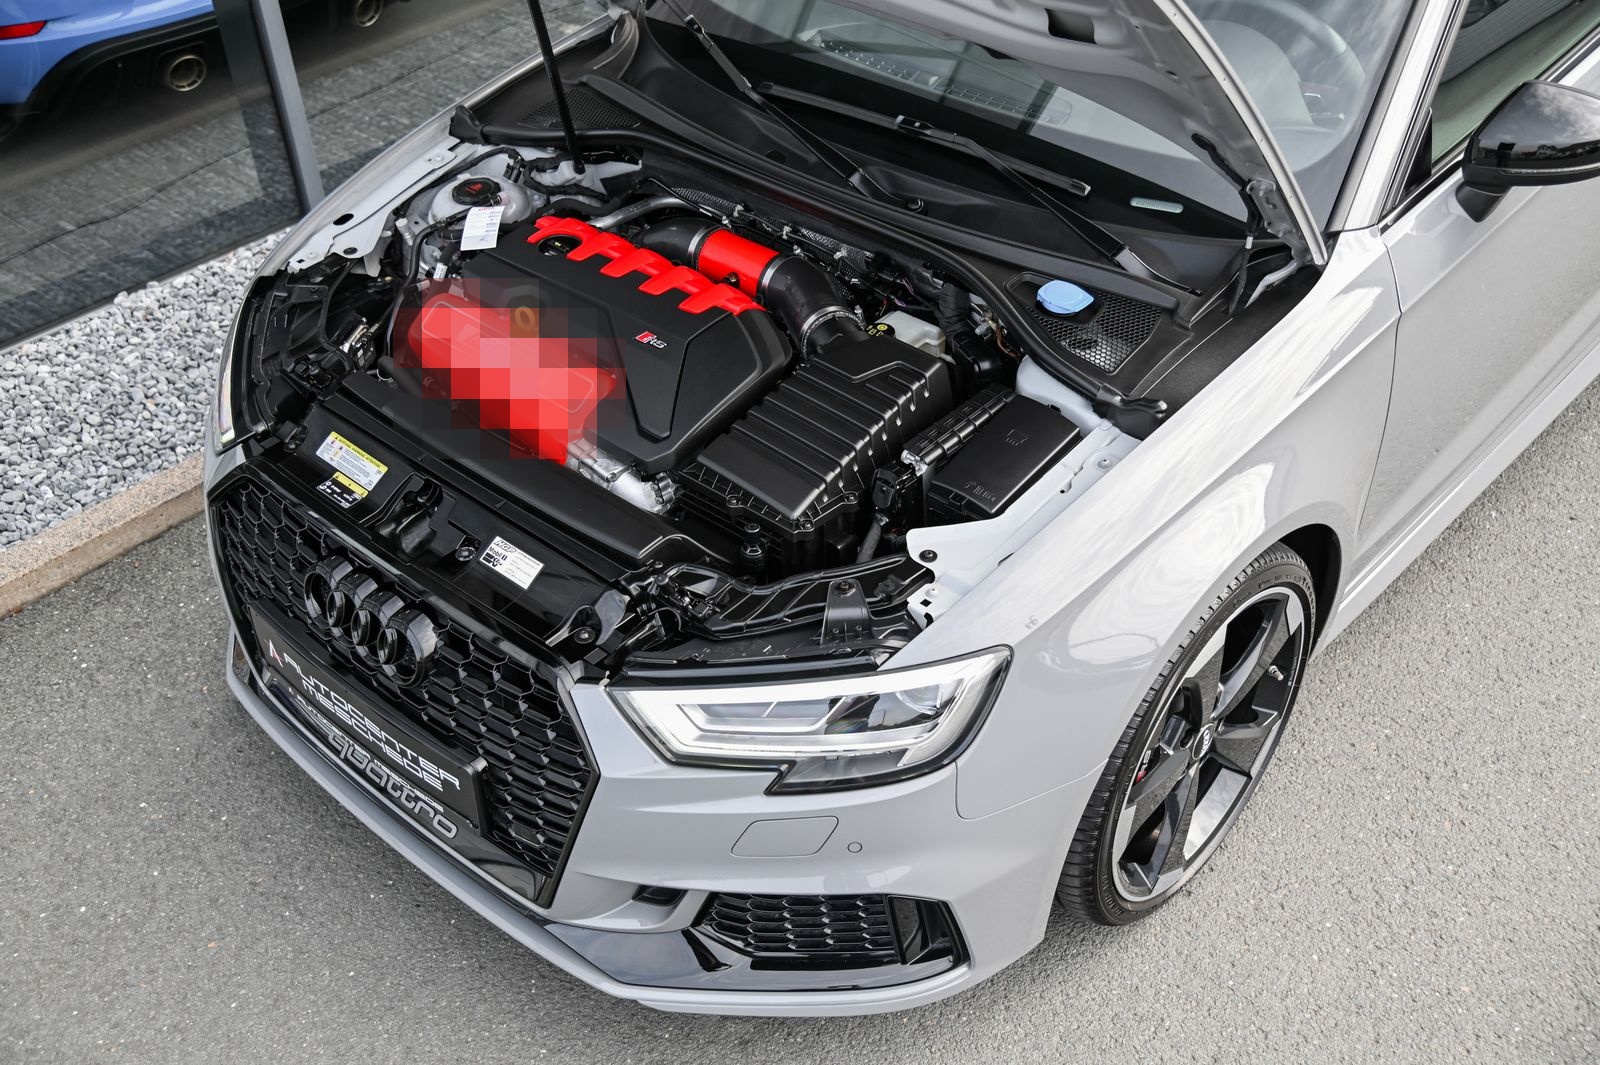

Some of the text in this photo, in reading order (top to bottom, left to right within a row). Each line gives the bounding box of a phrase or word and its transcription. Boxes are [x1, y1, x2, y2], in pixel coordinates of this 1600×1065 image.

[283, 652, 461, 791] AUTOCENTER
[302, 679, 444, 792] MESCHEDE
[328, 731, 458, 839] quattro
